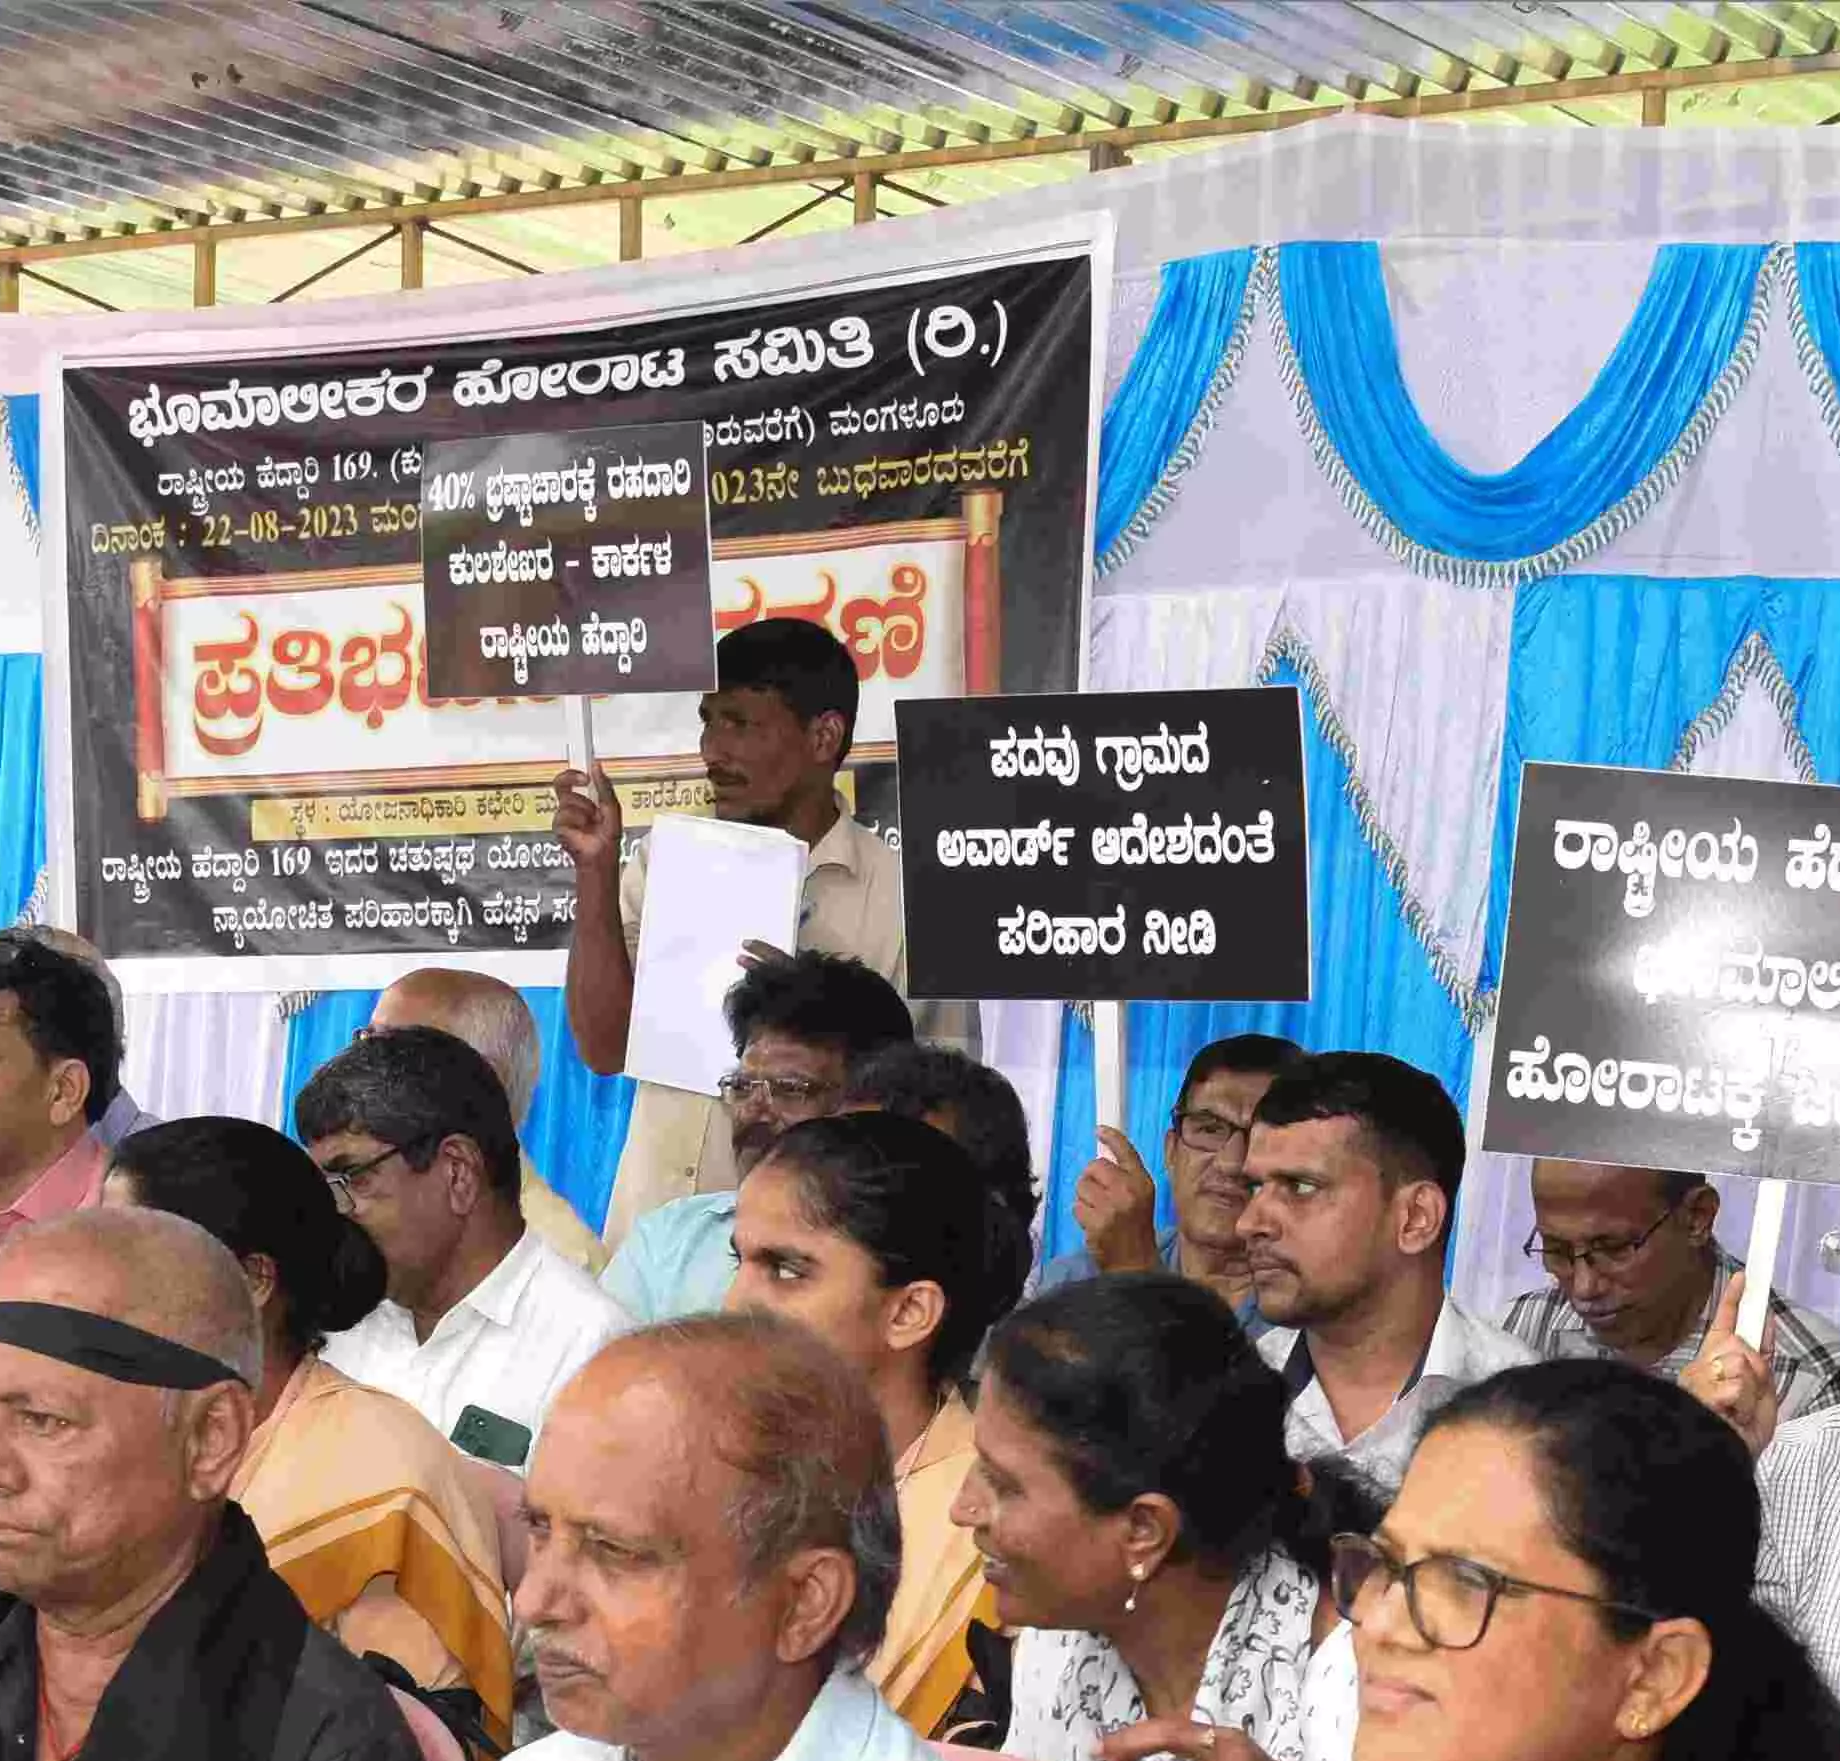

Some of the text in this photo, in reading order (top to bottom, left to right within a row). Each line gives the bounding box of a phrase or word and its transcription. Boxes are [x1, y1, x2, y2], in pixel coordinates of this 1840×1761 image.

[128, 300, 1008, 447] ಭೂಮಾಲೀಕರ ಹೋರಾಟ ಸಮಿತಿ (ರಿ.)
[158, 462, 244, 516] ರಾಷ್ಟ್ರೀಯ
[257, 456, 319, 500] ಹೆದ್ದಾರಿ
[829, 391, 966, 436] ಮಂಗಳೂರು
[90, 516, 166, 554] ದಿನಾಂಕ
[201, 503, 359, 548] 22-08-2023
[712, 463, 799, 505] 023ನೇ
[817, 437, 1029, 499] ಬುಧವಾರದವರೆಗೆ
[427, 455, 691, 528] 40% ಭ್ರಷ್ಟಾಚಾರಕ್ಕೆ ರಹದಾರಿ
[448, 536, 554, 585] ಕುಲಶೇಖರ
[591, 531, 672, 578] ಕಾರ್ಕಳ
[479, 613, 570, 685] ರಾಷ್ಟ್ರೀಯ
[580, 611, 648, 674] ಹೆದ್ದಾರಿ
[989, 720, 1210, 792] ಪದವು ಗ್ರಾಮದ
[101, 849, 182, 904] ರಾಷ್ಟ್ರೀಯ
[191, 846, 259, 893] ಹೆದ್ದಾರಿ
[271, 846, 312, 878] 169
[325, 843, 379, 878] ಇದರ
[389, 836, 475, 885] ಚತುಷ್ಪಥ
[936, 818, 1075, 868] ಅವಾರ್ಡ್
[1091, 808, 1276, 866] ಆದೇಶದಂತೆ
[1553, 816, 1759, 918] ರಾಷ್ಟ್ರೀಯ
[212, 896, 335, 951] ನ್ಯಾಯೋಚಿತ
[344, 895, 472, 944] ಪರಿಹಾರಕ್ಕಾಗಿ
[482, 889, 543, 944] ಹೆಚ್ಚಿನ
[997, 903, 1217, 956] ಪರಿಹಾರ ನೀಡಿ
